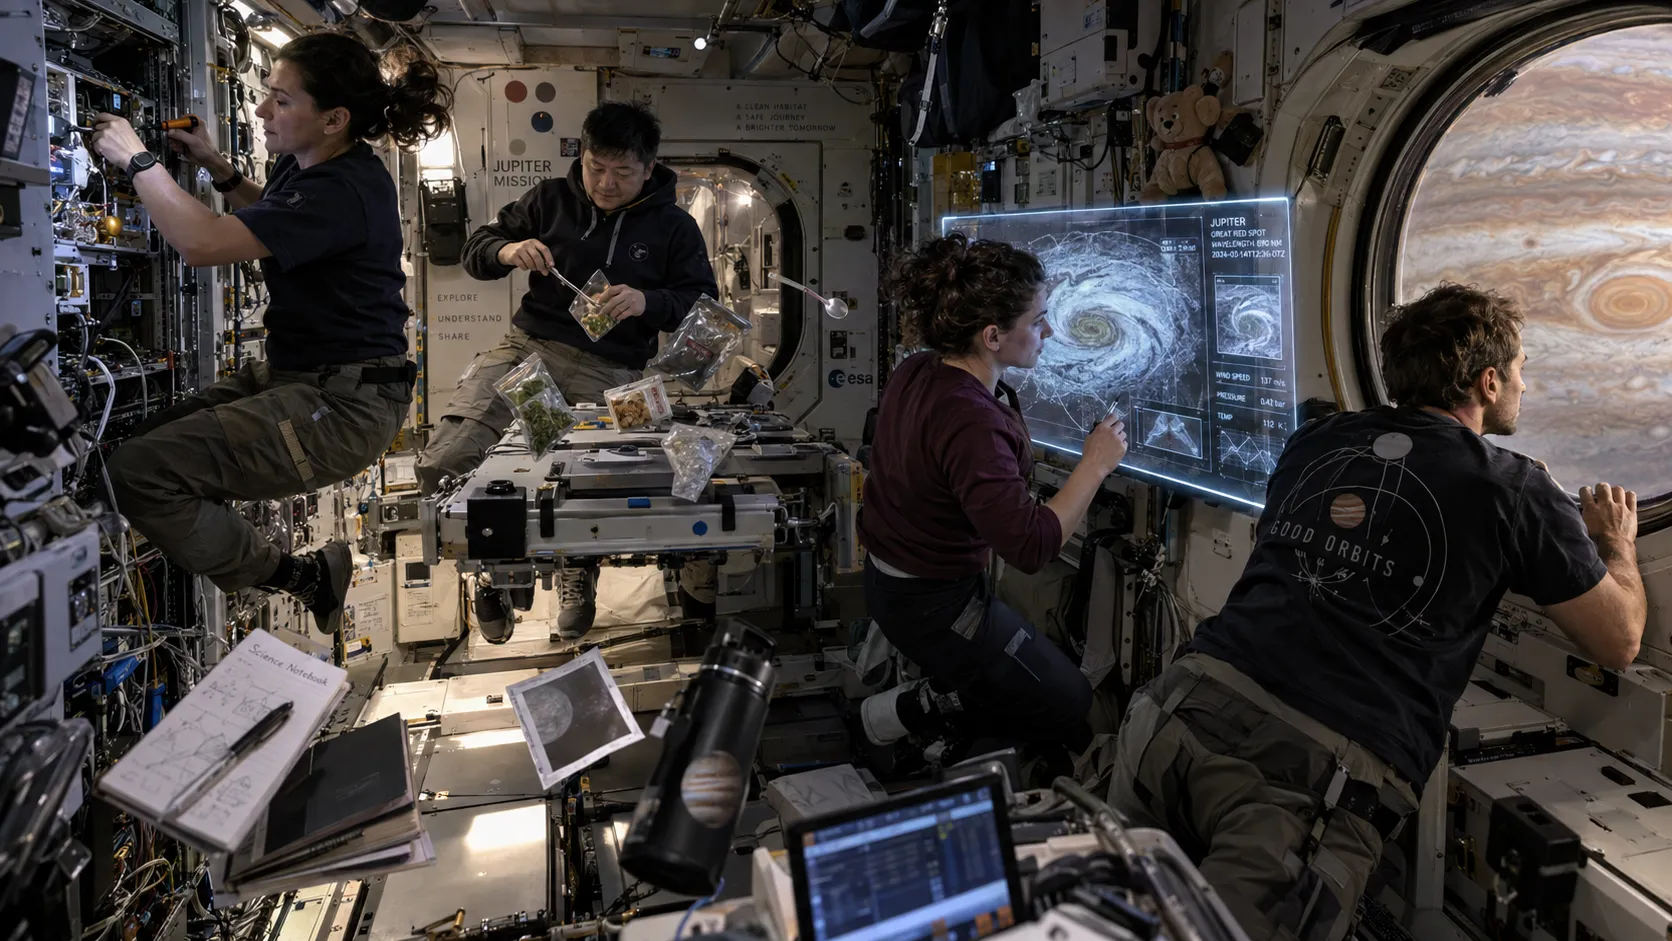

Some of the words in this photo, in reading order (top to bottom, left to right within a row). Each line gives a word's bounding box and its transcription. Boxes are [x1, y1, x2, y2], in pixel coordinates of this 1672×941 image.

[745, 124, 785, 132] BRIGHTER
[788, 124, 836, 132] TOMORROW
[493, 160, 552, 172] JUPITER
[1210, 217, 1246, 228] JUPITER
[1211, 230, 1231, 238] GREAT
[1233, 229, 1247, 237] RED
[1248, 229, 1266, 237] SPOT
[437, 294, 478, 302] EXPLORE
[437, 314, 502, 323] UNDERSTAND
[438, 333, 470, 341] SHARE
[847, 373, 874, 385] esa
[1215, 371, 1231, 379] WIND
[1231, 373, 1251, 381] SPEED
[1270, 519, 1315, 543] GOOD
[1324, 534, 1396, 578] ORBITS
[248, 643, 284, 668] Science
[286, 663, 329, 687] Notebook
